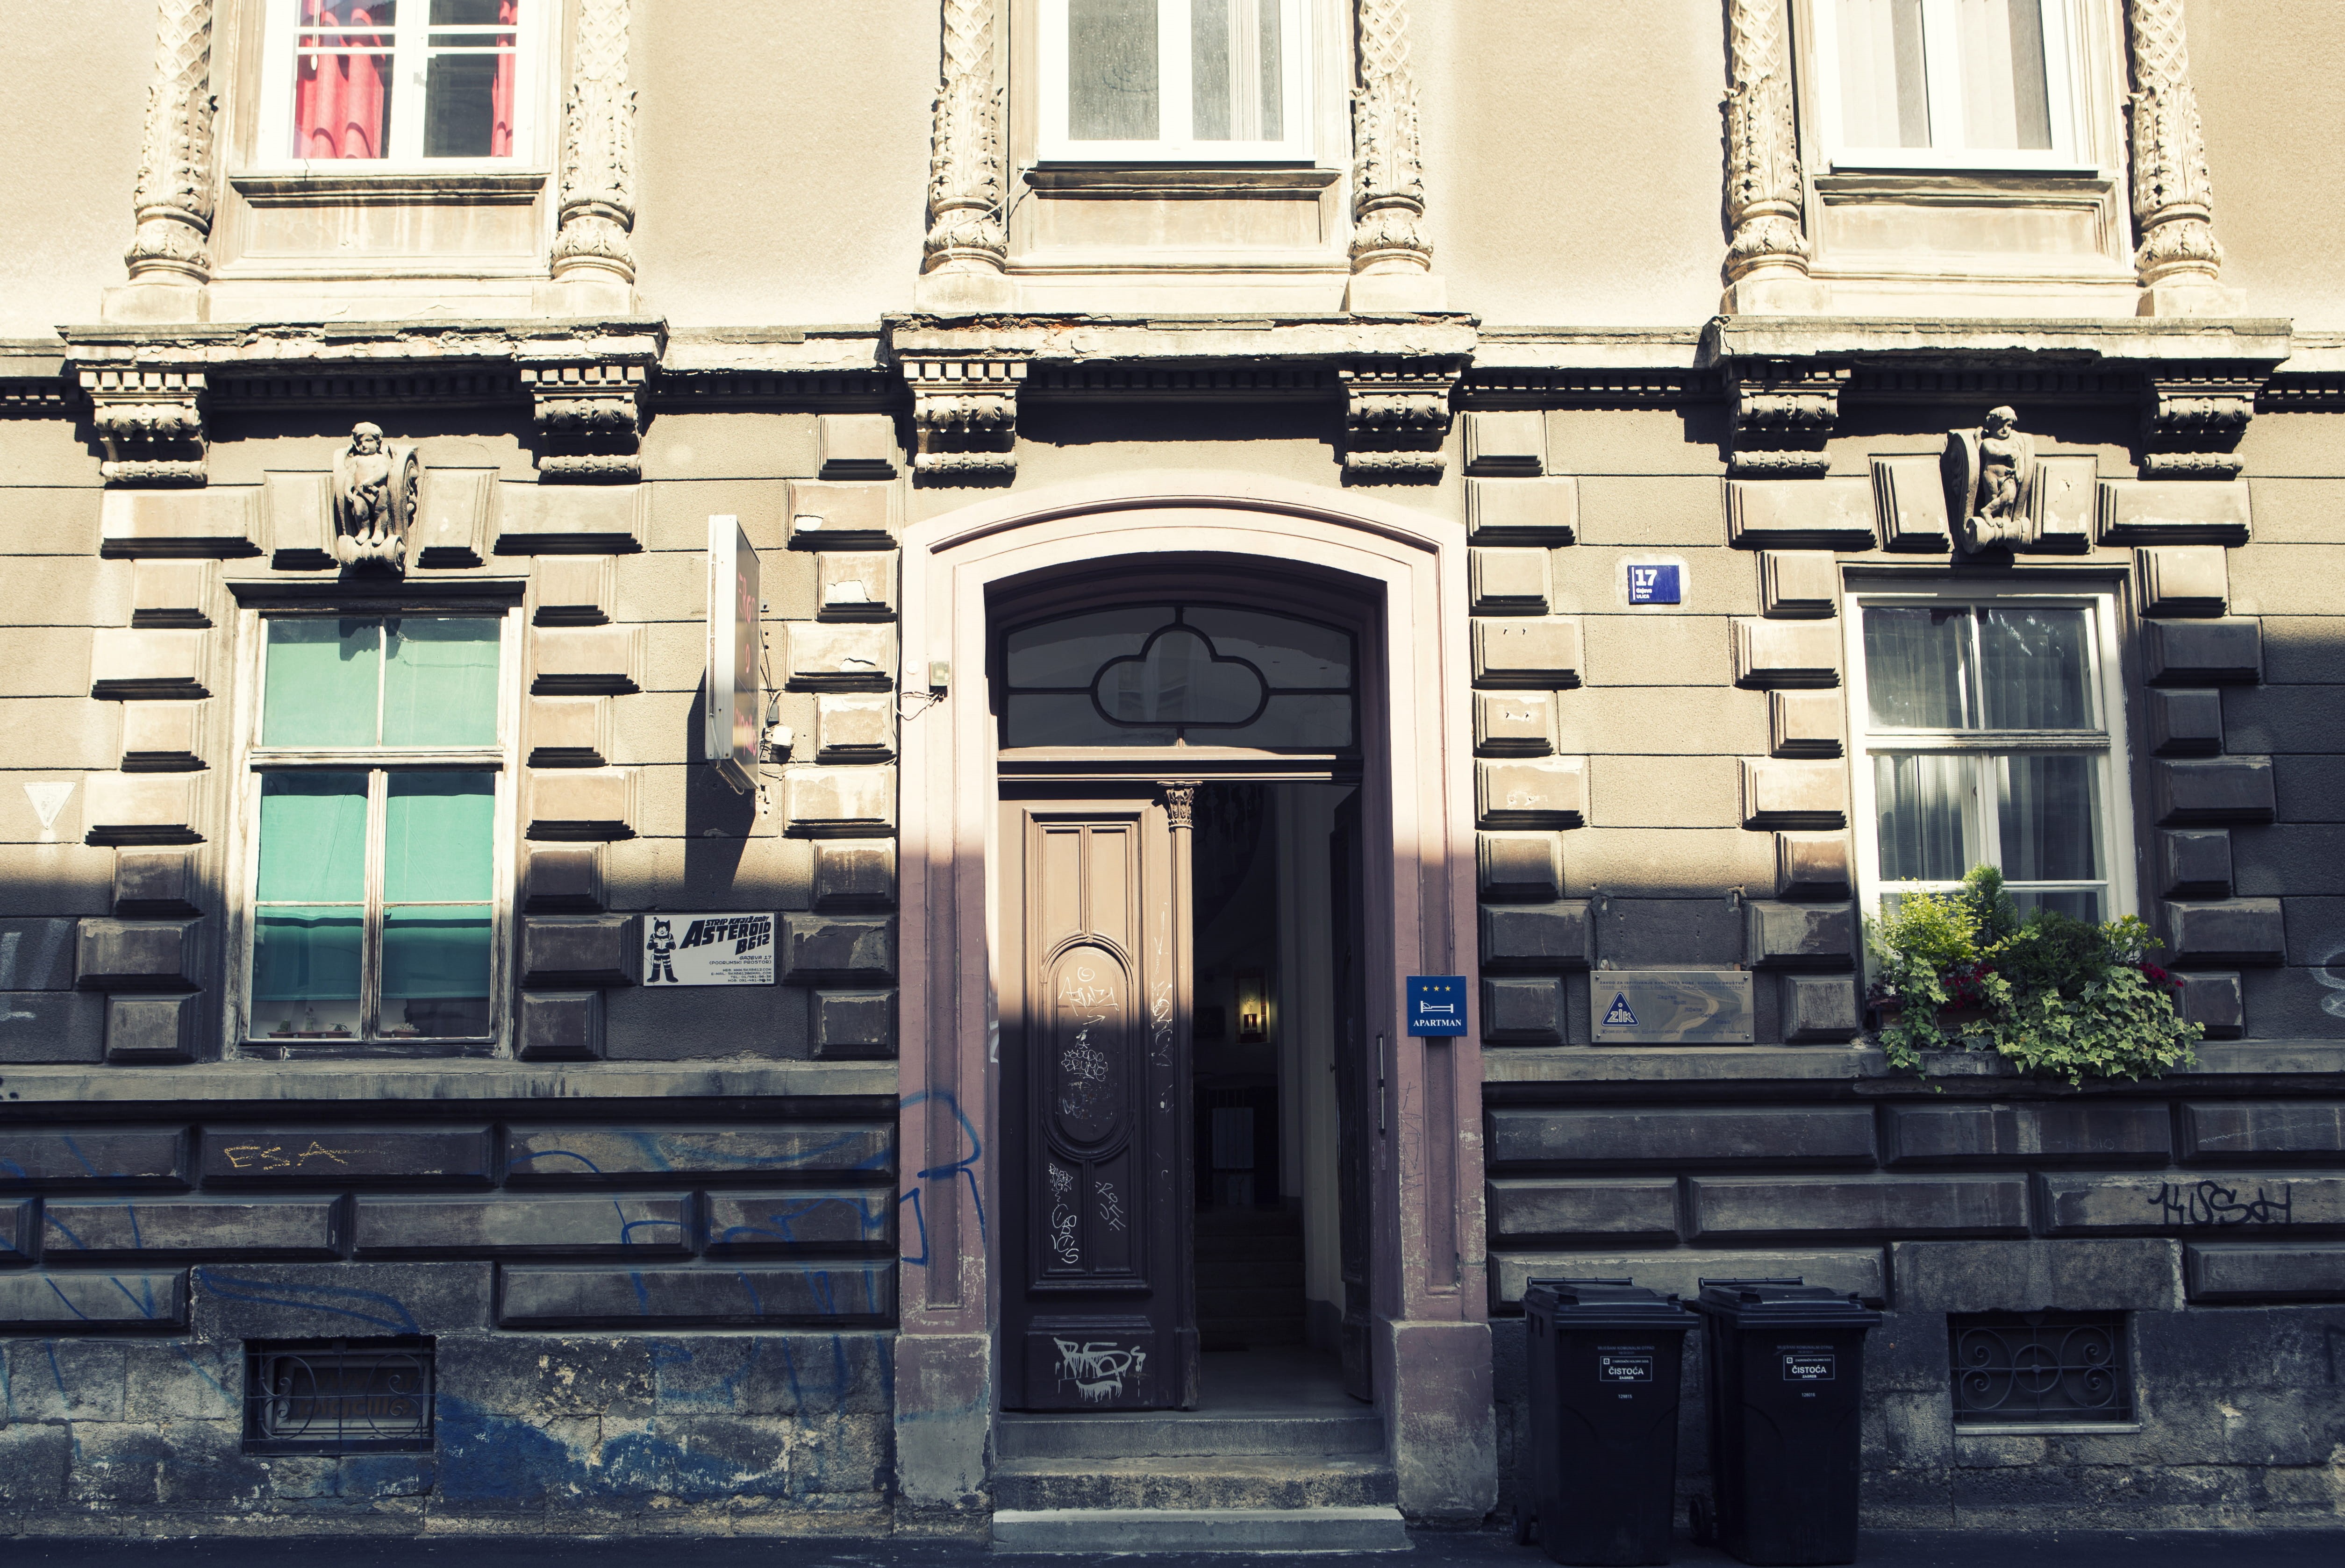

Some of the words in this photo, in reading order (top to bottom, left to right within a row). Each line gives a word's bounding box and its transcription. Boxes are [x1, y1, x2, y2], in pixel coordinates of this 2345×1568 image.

[1635, 569, 1657, 586] 17
[679, 919, 772, 949] ASTEROID
[735, 933, 770, 955] B612
[1609, 1366, 1644, 1375] ČISTOĆA
[1792, 1365, 1826, 1374] ČISTOĆA
